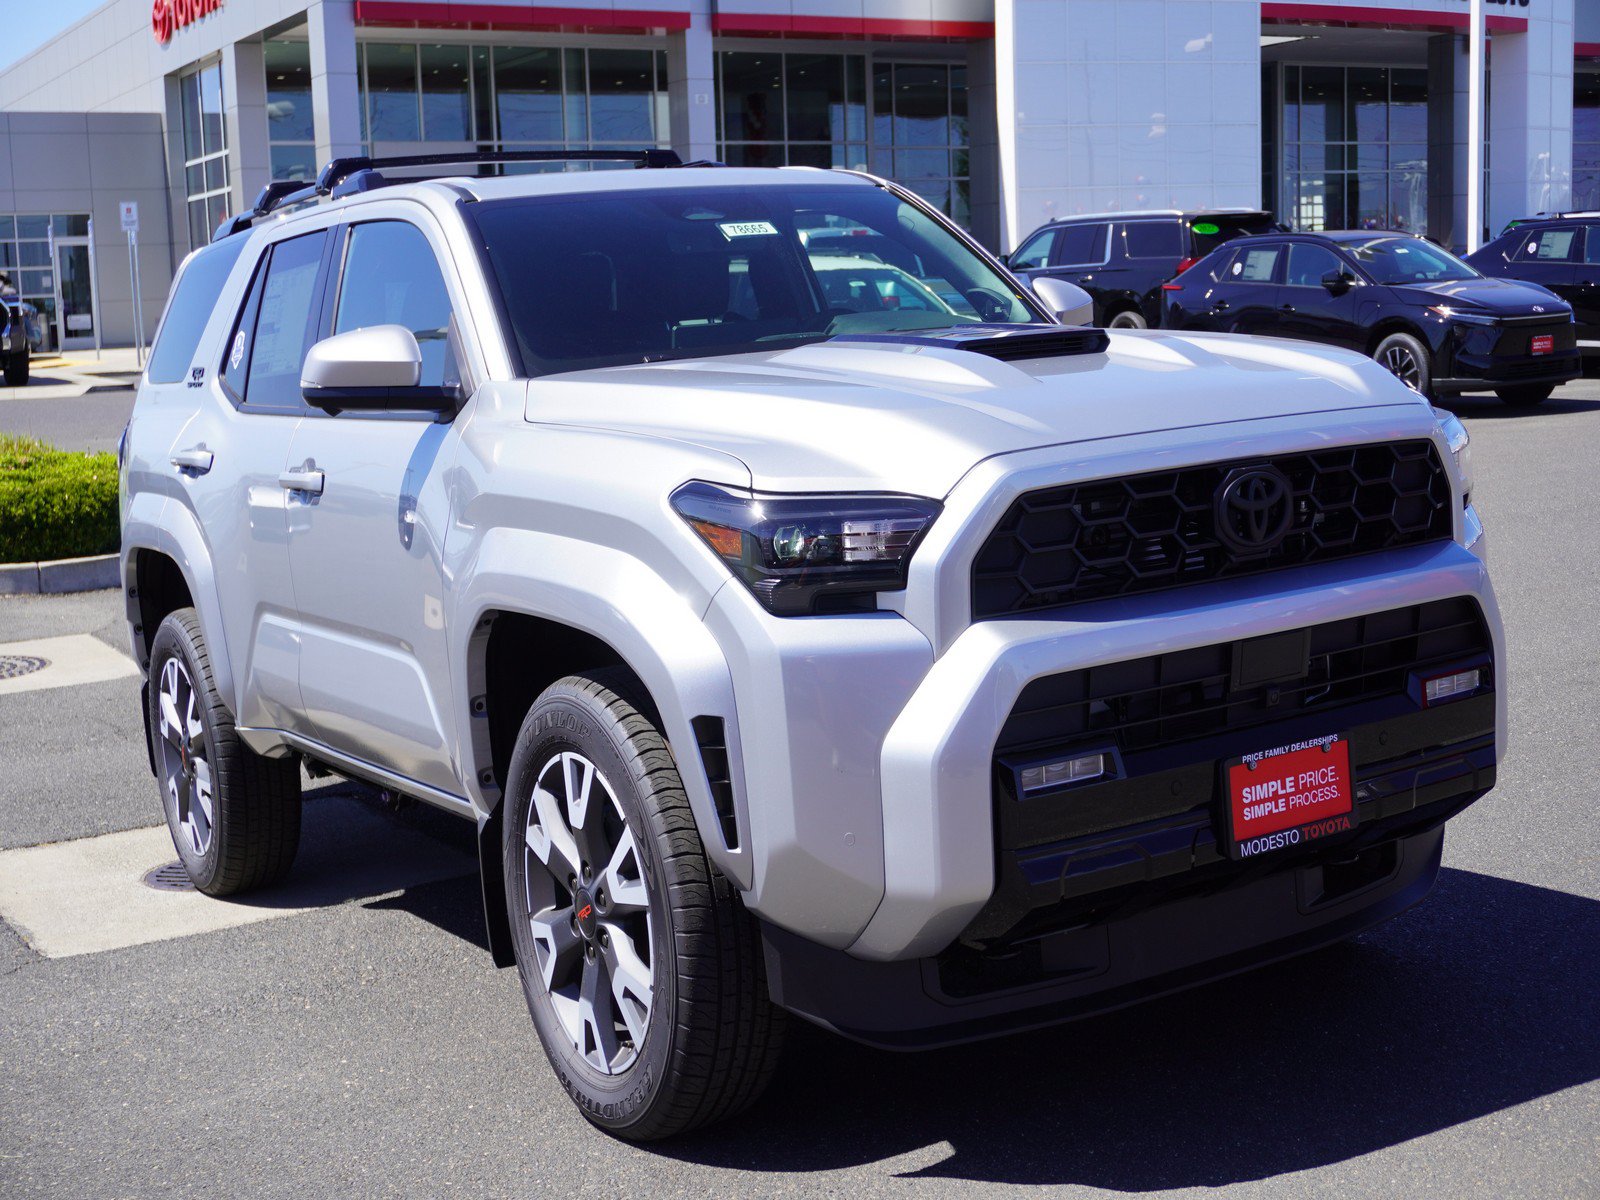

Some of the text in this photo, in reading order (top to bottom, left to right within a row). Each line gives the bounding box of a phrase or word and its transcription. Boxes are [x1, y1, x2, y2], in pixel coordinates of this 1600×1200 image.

[728, 224, 768, 235] 78665
[524, 710, 592, 749] DUNLOP
[1242, 734, 1338, 763] PRICE FAMILY DEALERSHIPS
[1242, 766, 1339, 804] SIMPLE PRICE.
[1243, 785, 1341, 821] SIMPLE PROCESS.
[1240, 816, 1351, 858] MODESTO TOYOTA
